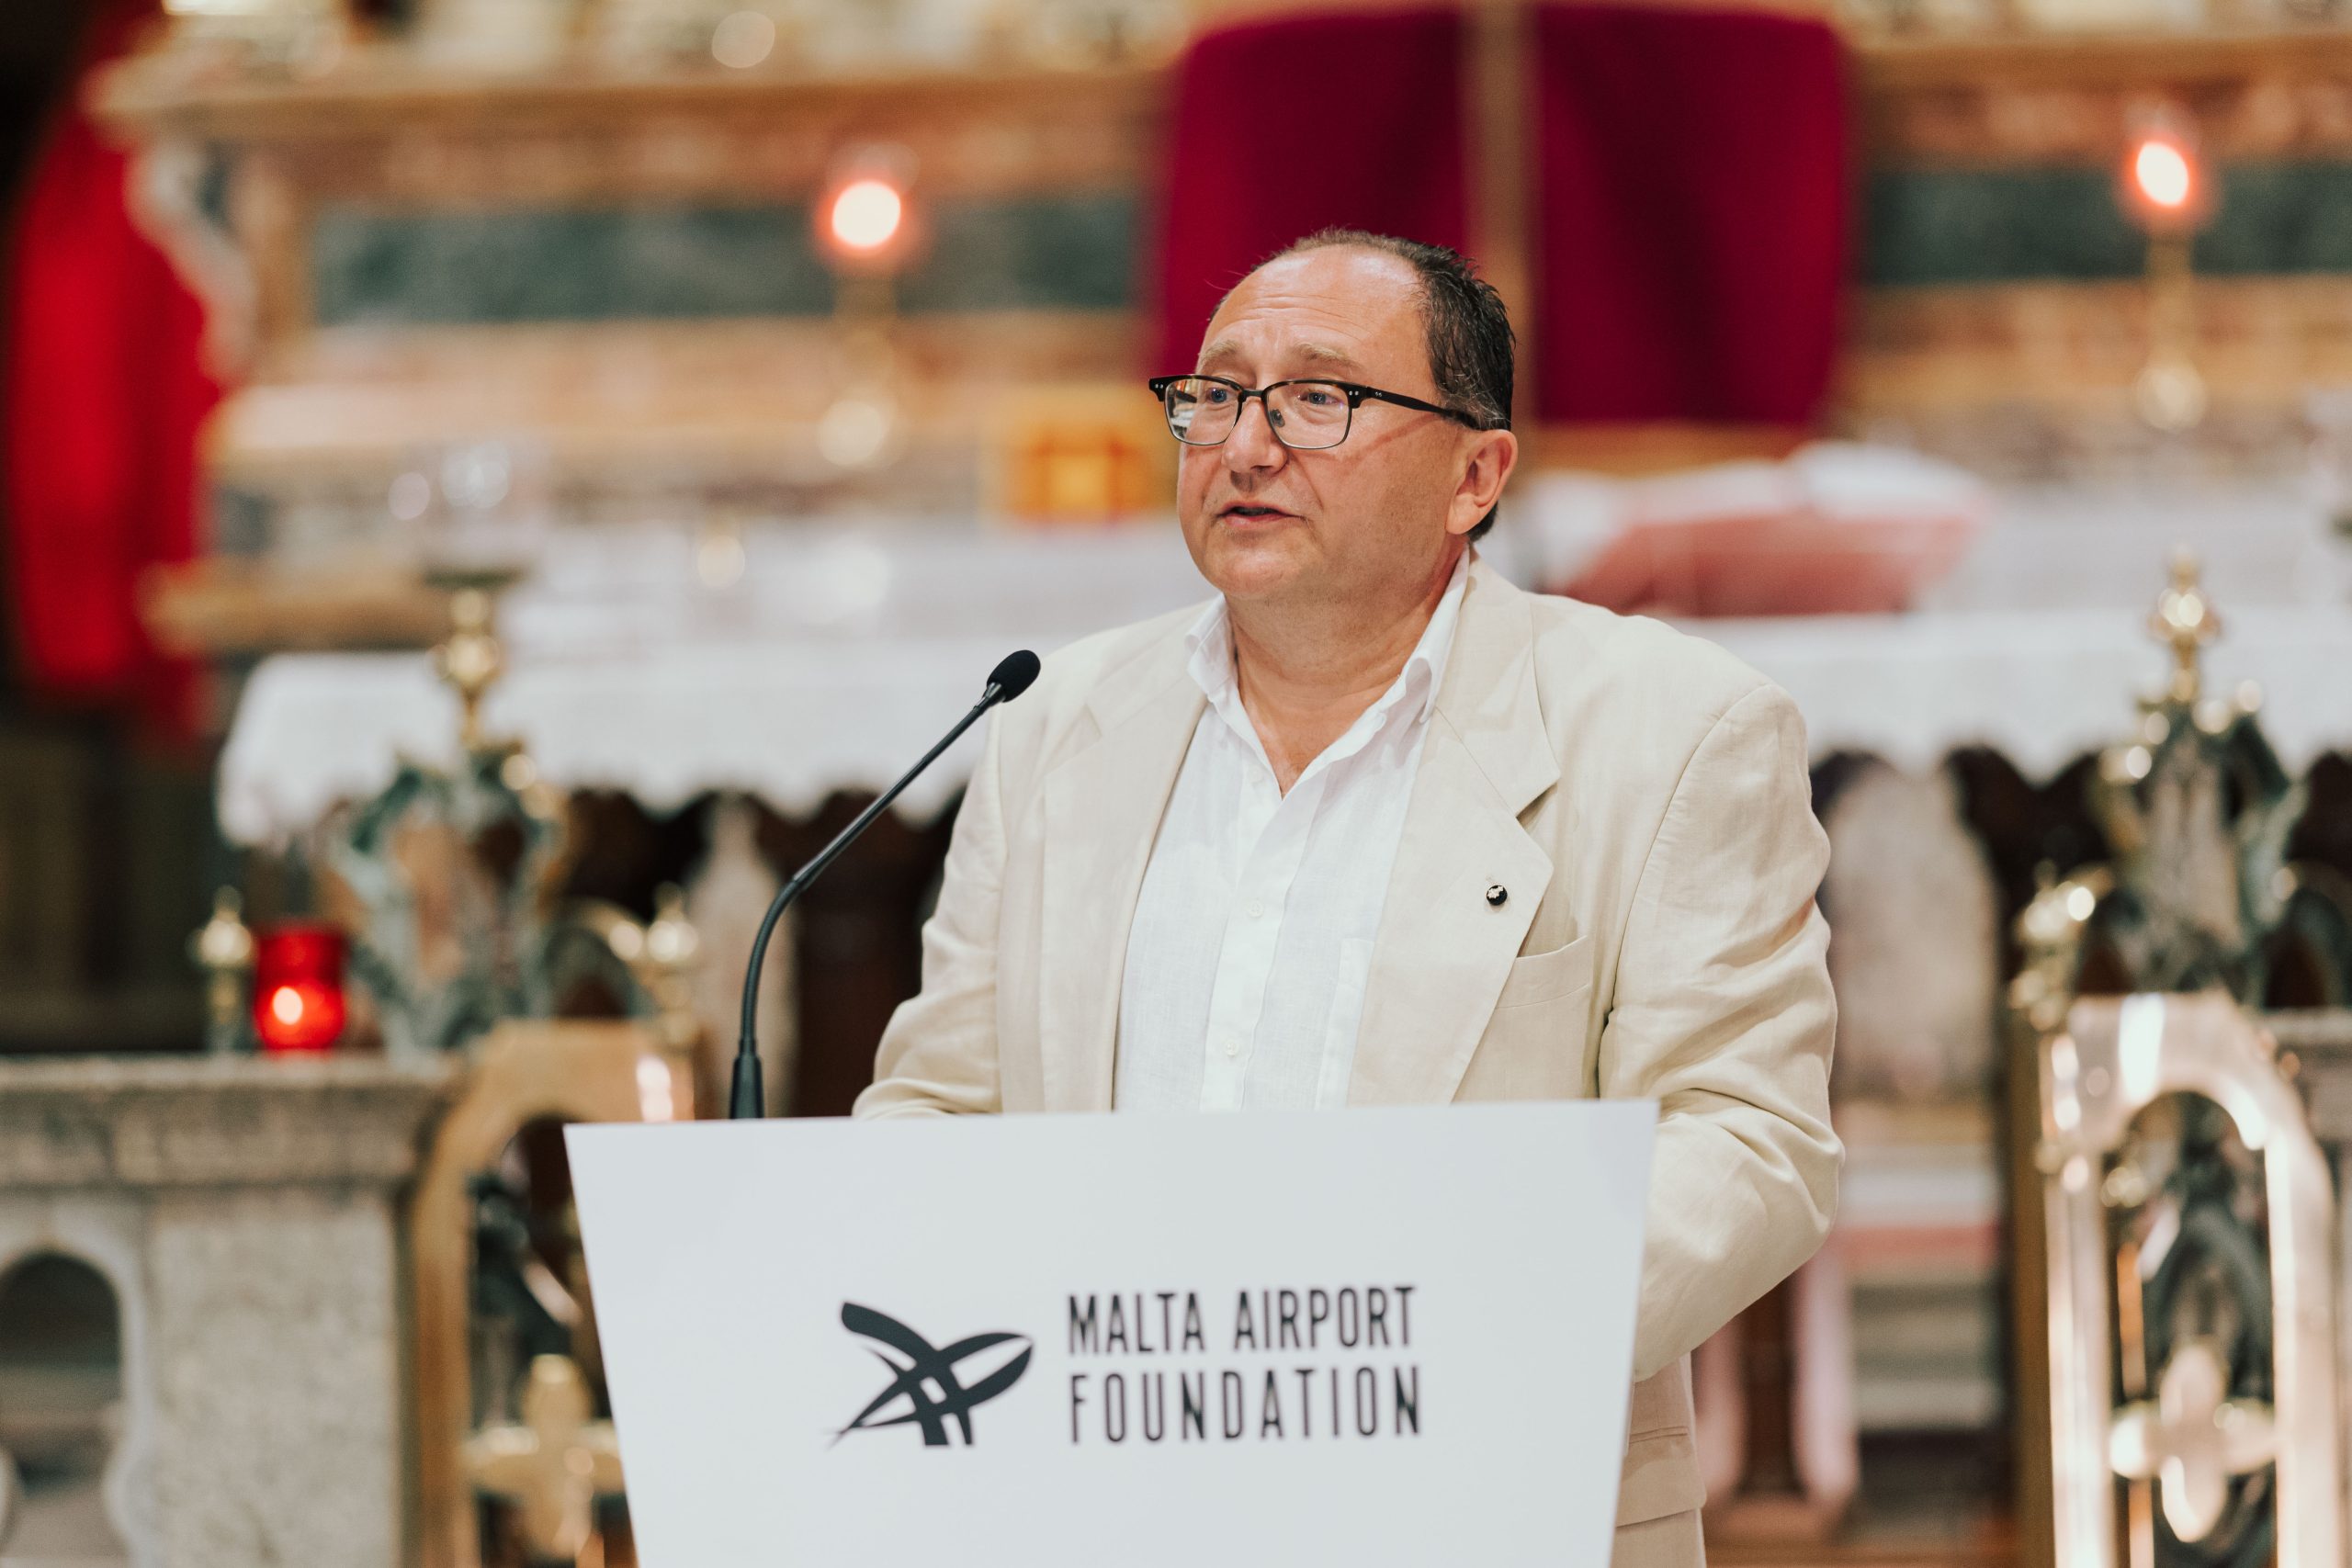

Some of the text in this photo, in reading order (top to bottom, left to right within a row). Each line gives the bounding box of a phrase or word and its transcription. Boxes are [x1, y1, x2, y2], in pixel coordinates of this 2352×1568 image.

[1068, 1286, 1416, 1355] MALTA AIRPORT
[1070, 1365, 1421, 1444] FOUNDATION
